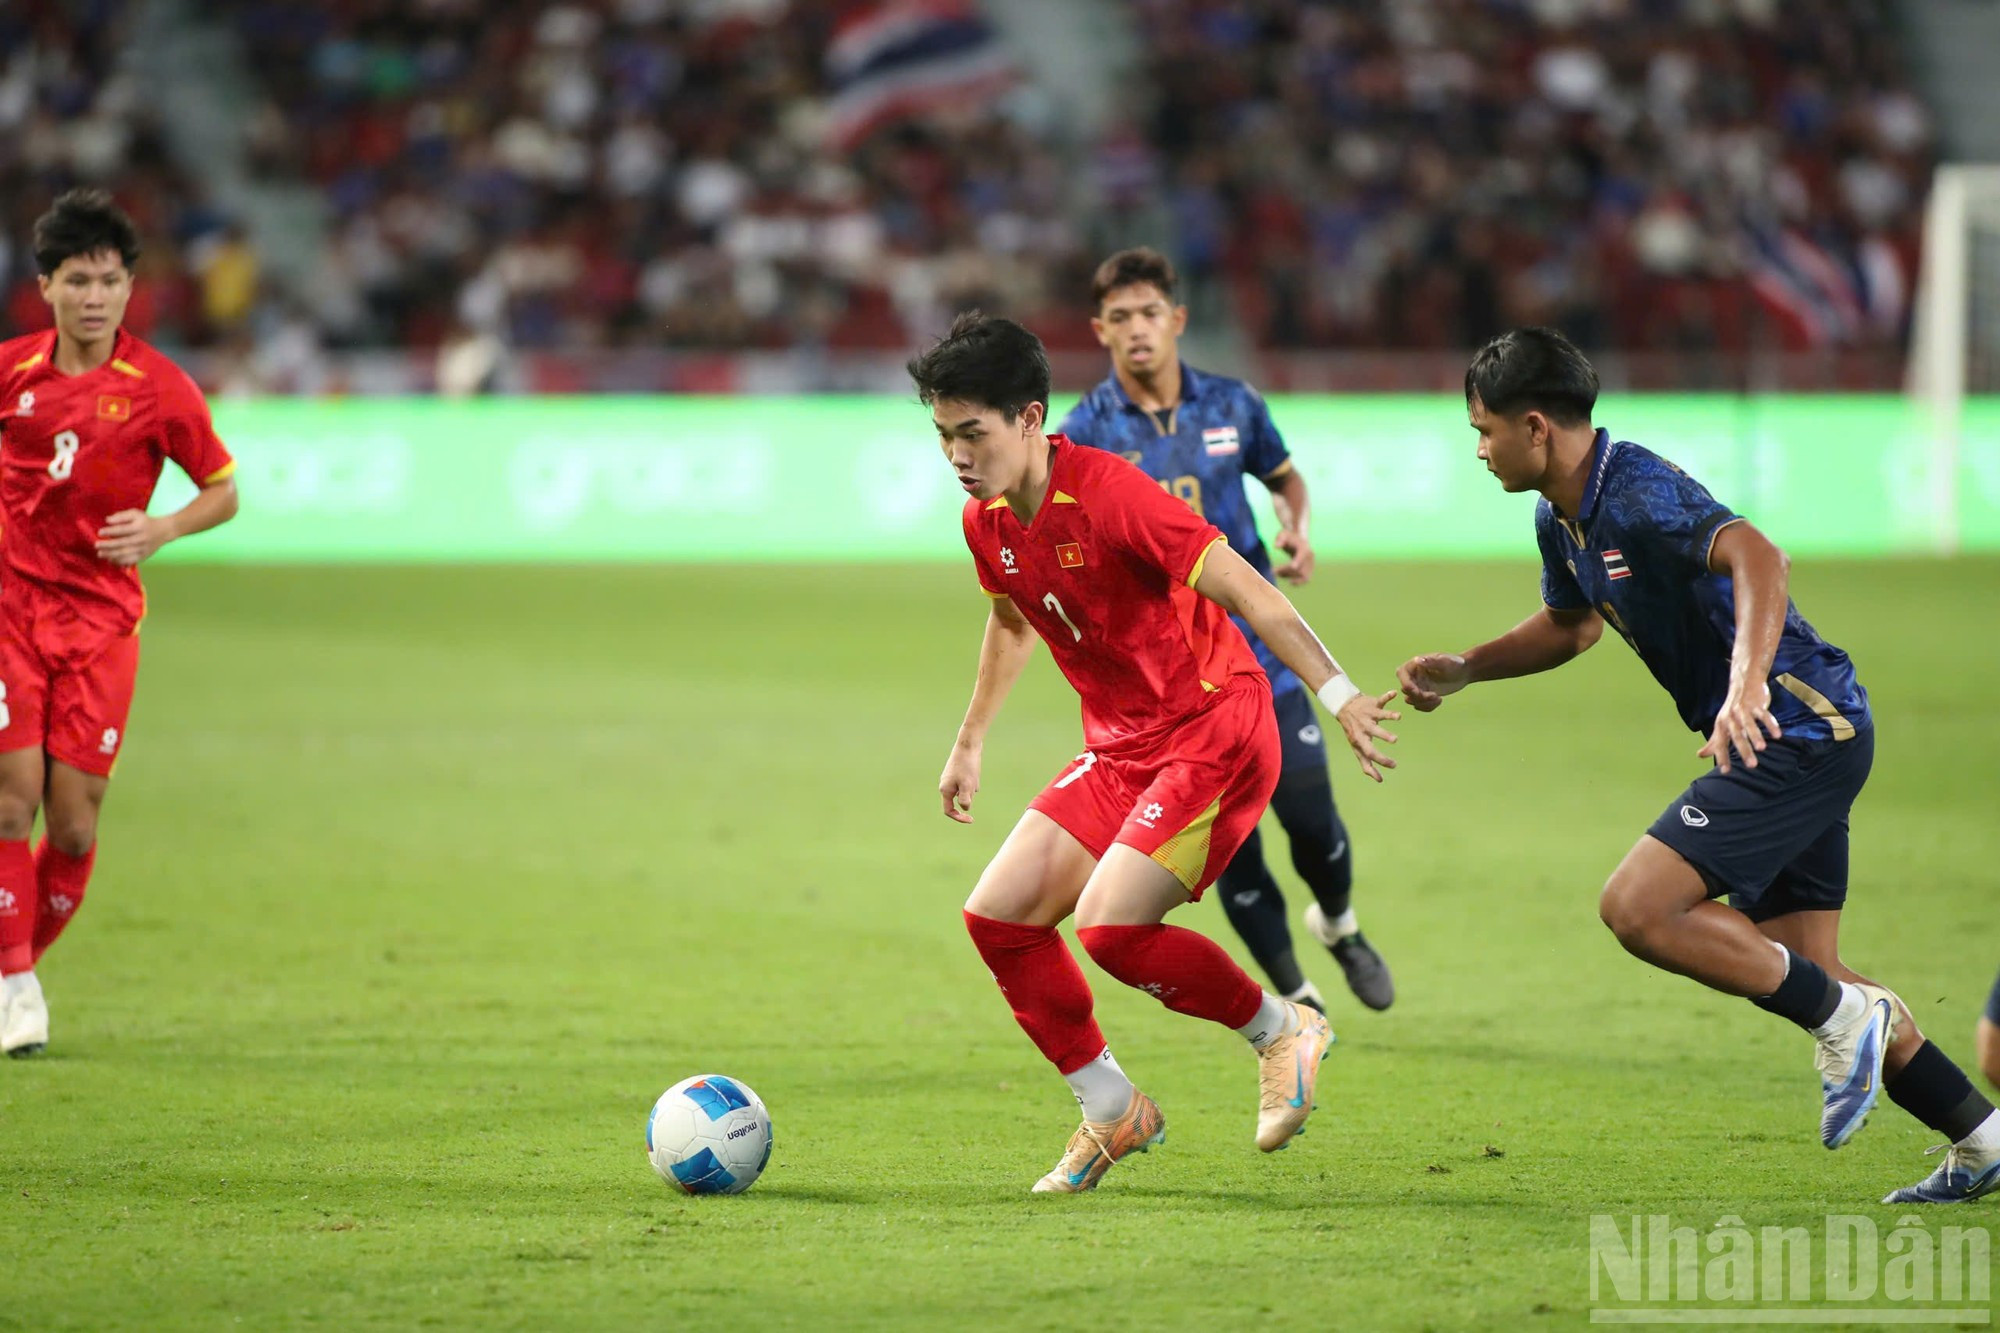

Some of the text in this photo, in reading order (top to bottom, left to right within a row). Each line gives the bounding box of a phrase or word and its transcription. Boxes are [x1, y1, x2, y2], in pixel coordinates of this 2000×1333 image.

[48, 430, 79, 480] 8
[1043, 592, 1082, 643] 7
[1053, 751, 1097, 788] 7
[727, 1121, 758, 1141] molten
